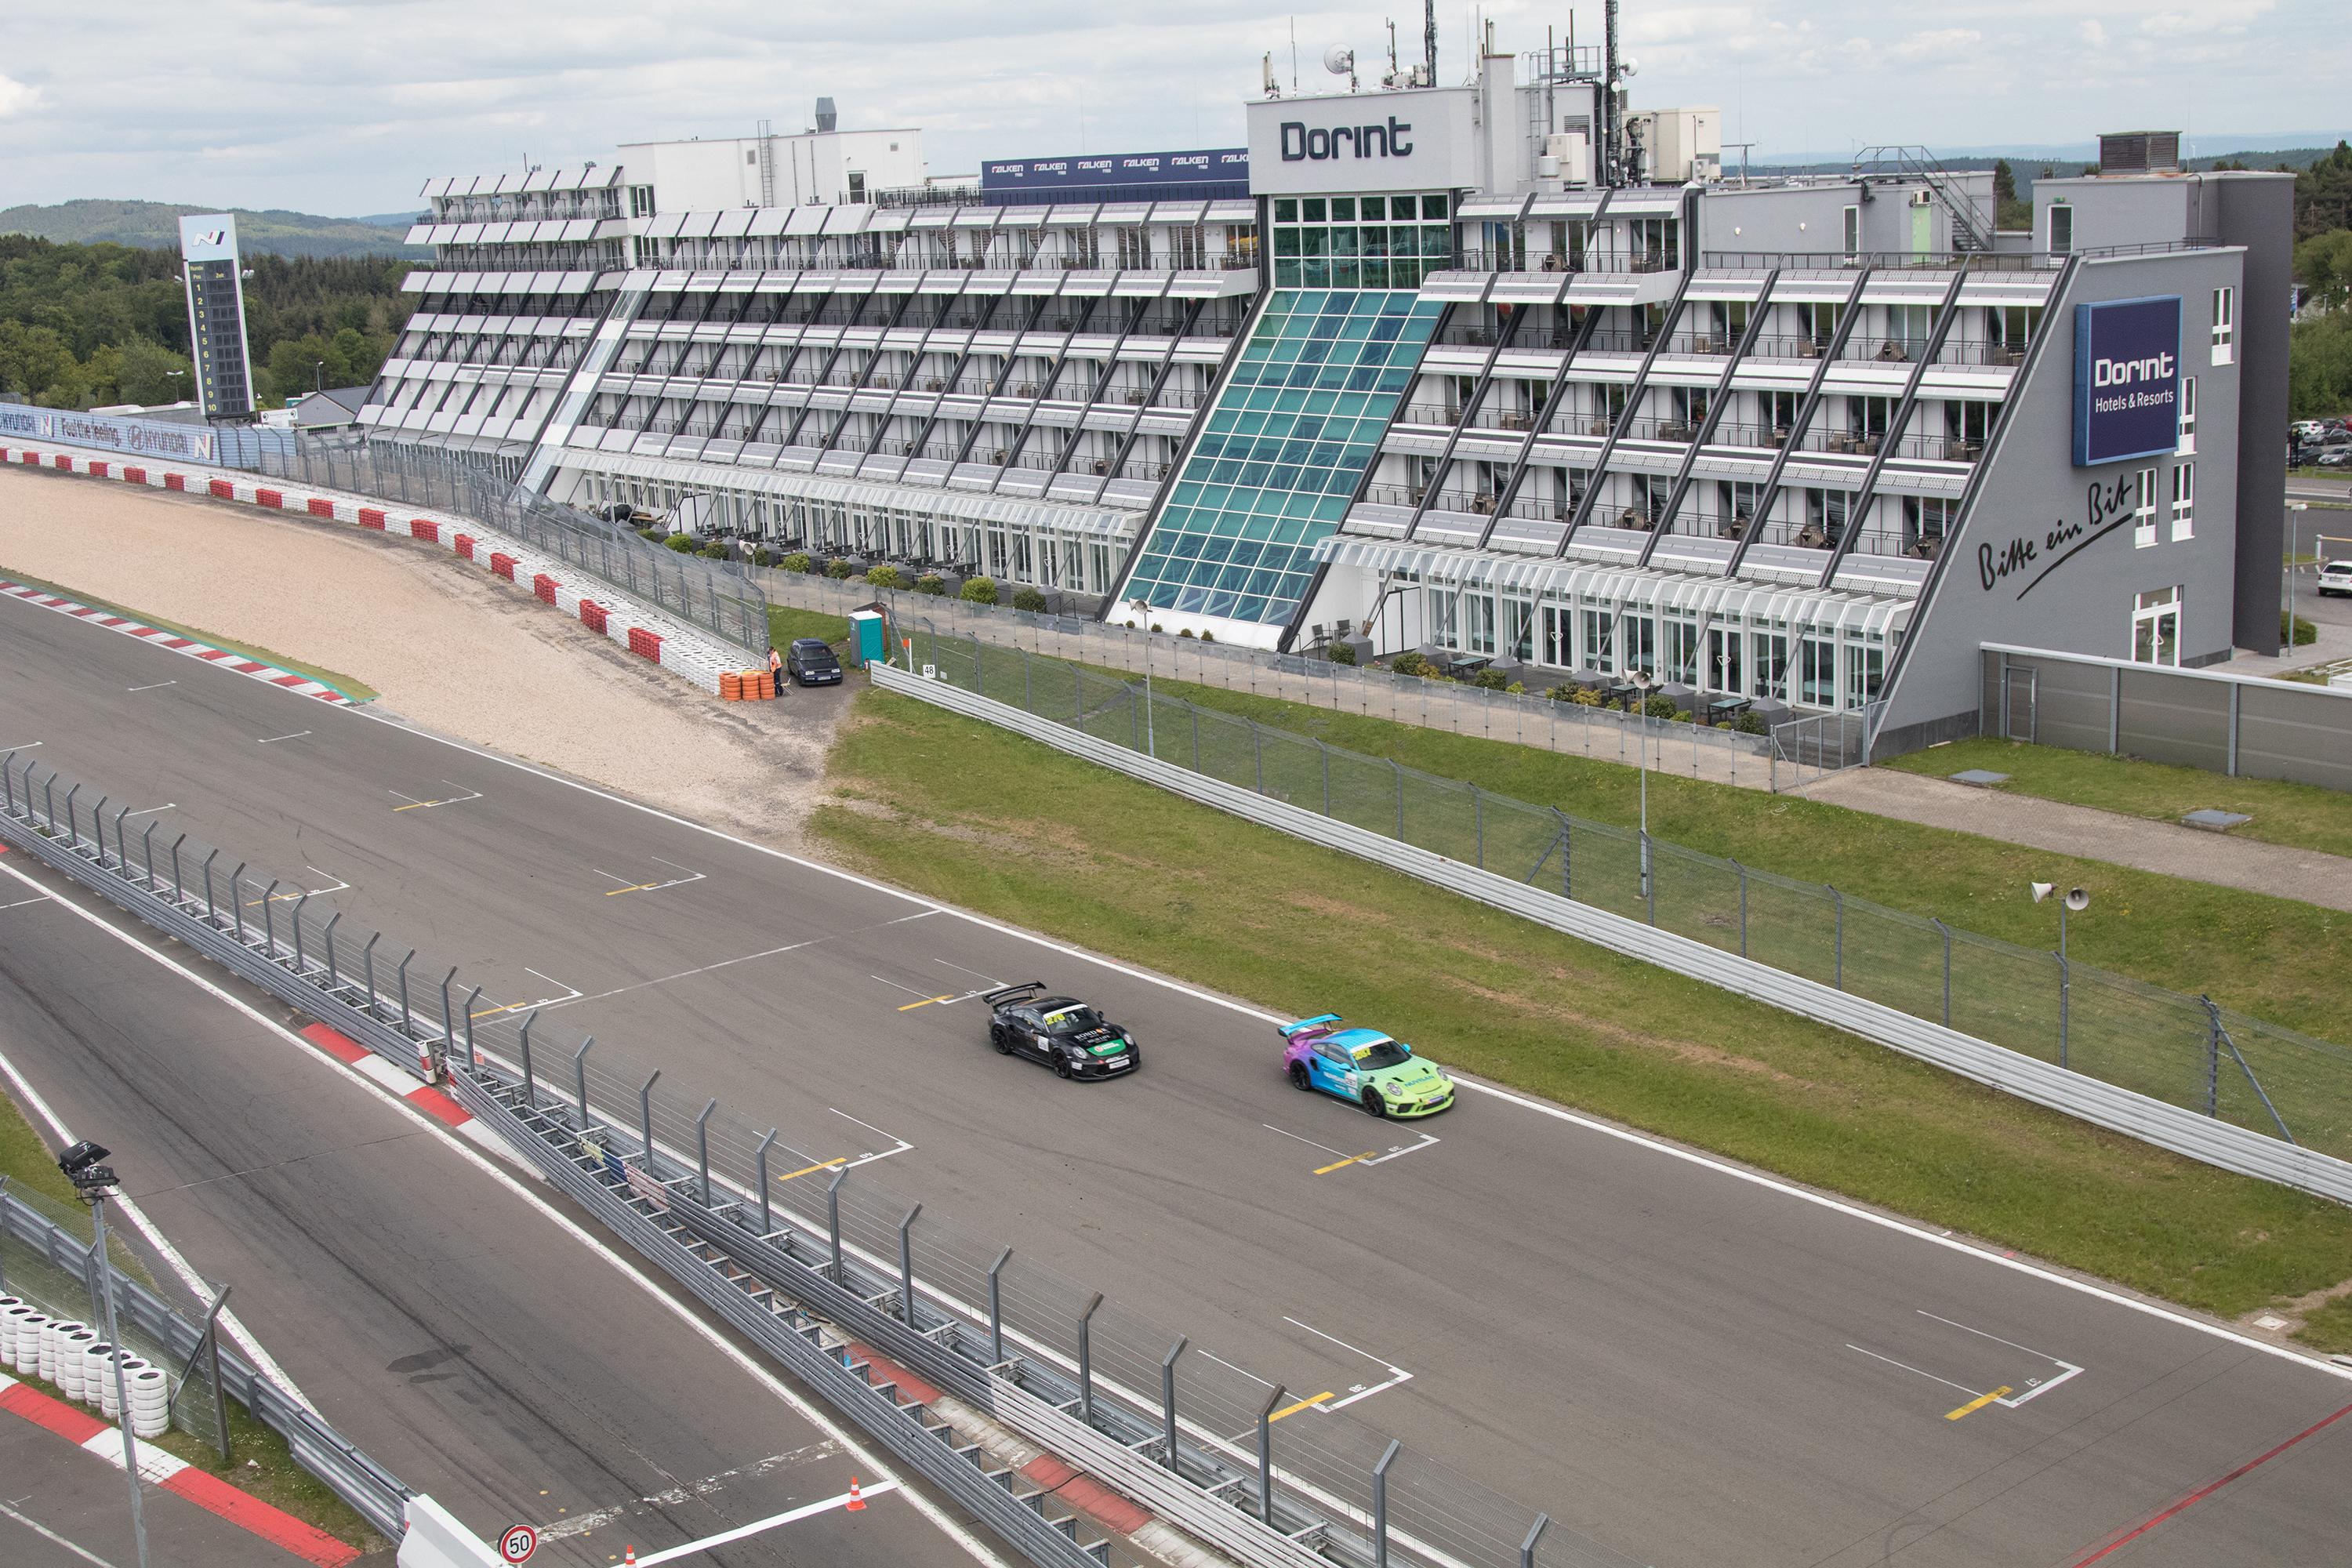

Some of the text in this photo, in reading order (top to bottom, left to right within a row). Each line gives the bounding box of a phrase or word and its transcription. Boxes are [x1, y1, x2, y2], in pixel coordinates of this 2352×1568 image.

[1280, 115, 1413, 162] Dorint
[1123, 158, 1160, 168] FALKEN
[1171, 156, 1209, 165] FALKEN
[1221, 154, 1248, 163] FALK
[992, 164, 1024, 173] FALKEN
[1034, 162, 1067, 172] FALKEN
[1077, 160, 1112, 169] FALKEN
[2095, 352, 2174, 387] Dorint
[2095, 389, 2174, 413] Hotels & Resorts
[144, 430, 189, 454] HYUNDAI
[1978, 474, 2132, 591] Bitte ein Bit
[924, 666, 934, 674] 48
[510, 1534, 530, 1555] 50
